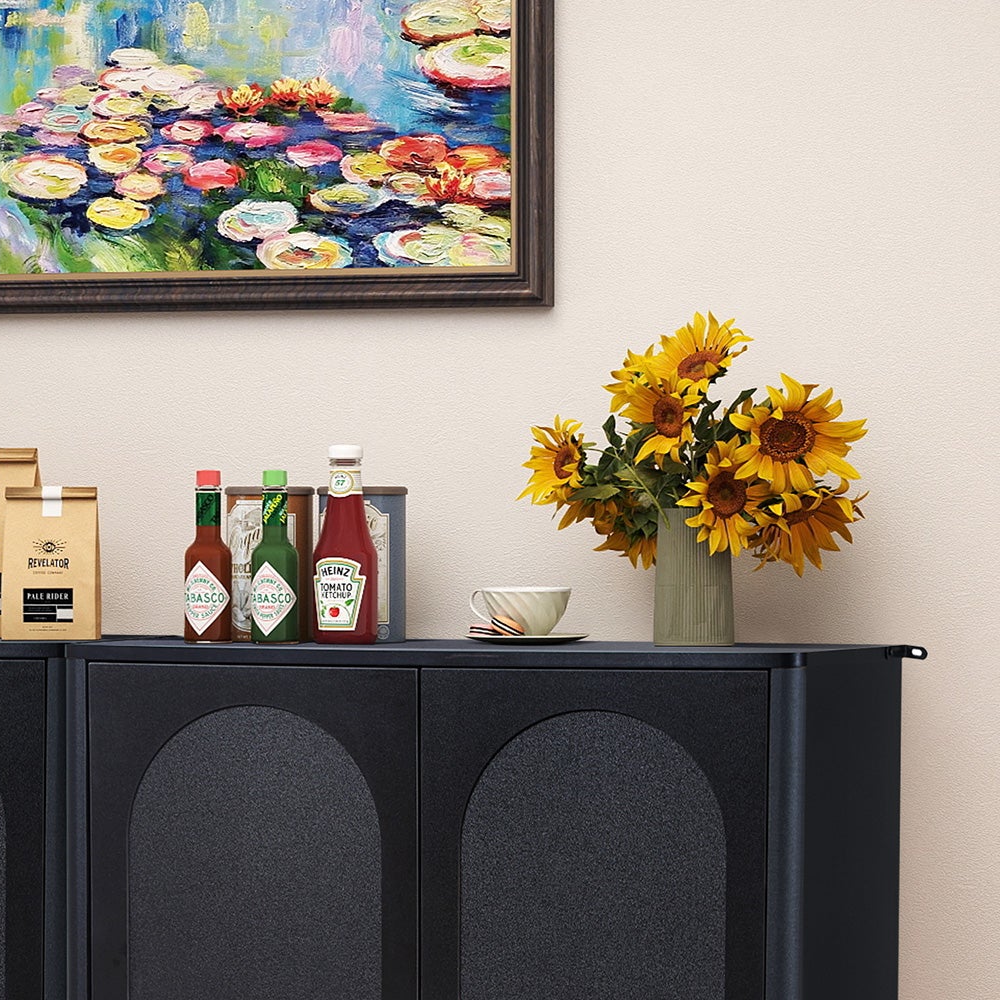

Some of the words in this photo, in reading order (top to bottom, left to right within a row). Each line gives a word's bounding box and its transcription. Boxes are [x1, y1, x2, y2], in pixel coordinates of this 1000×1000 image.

[28, 557, 70, 570] REVELATOR
[321, 566, 351, 577] HEINZ
[320, 582, 353, 592] TOMATO
[27, 592, 44, 600] PALE
[46, 592, 69, 600] RIDER
[320, 591, 352, 599] KETCHUP
